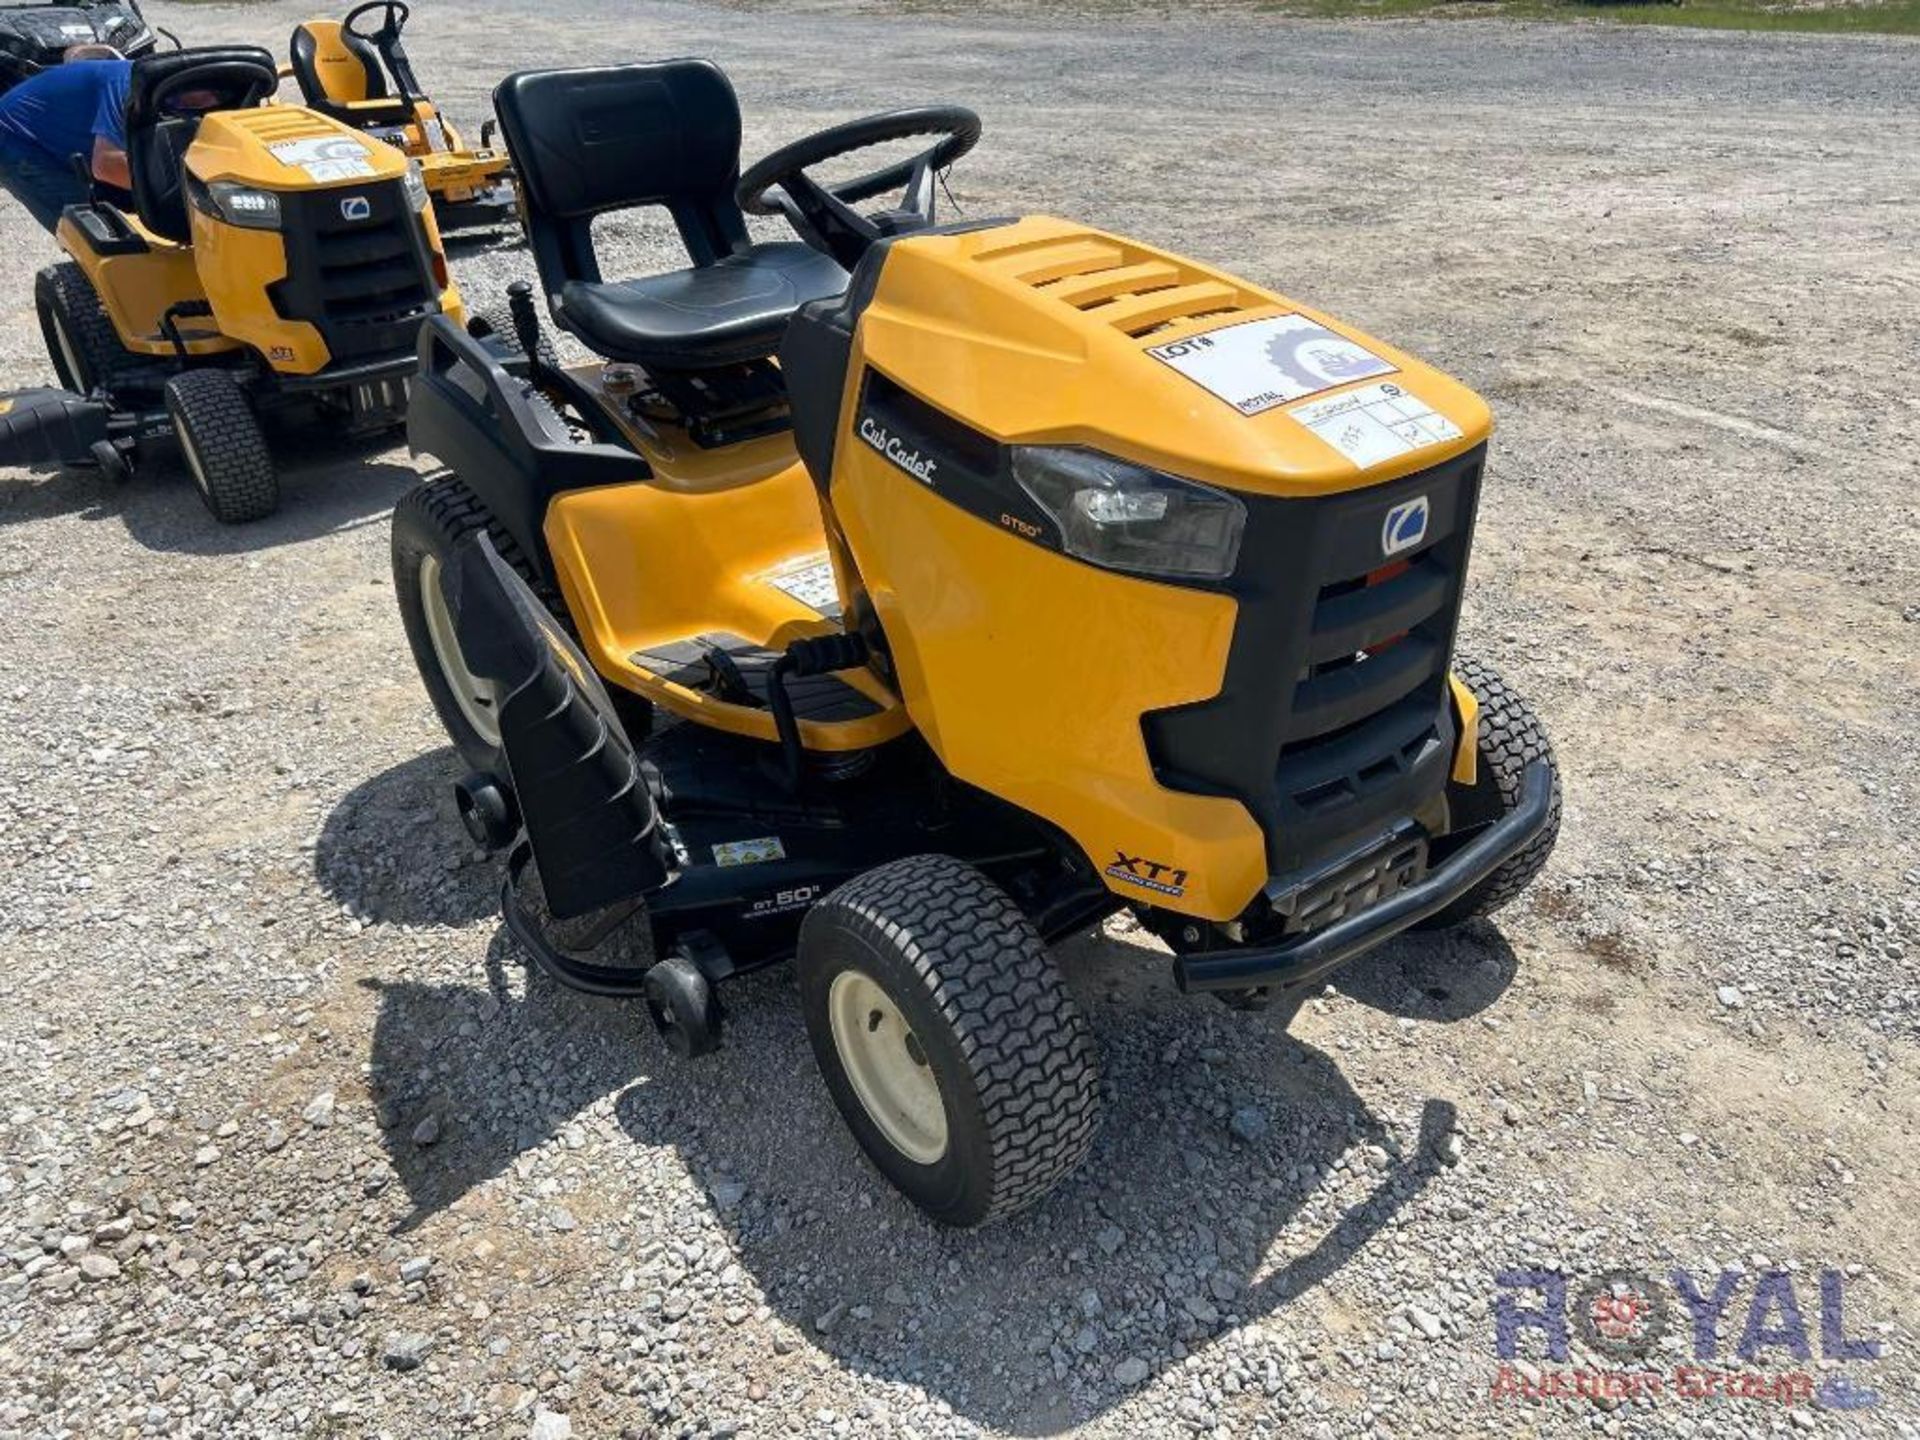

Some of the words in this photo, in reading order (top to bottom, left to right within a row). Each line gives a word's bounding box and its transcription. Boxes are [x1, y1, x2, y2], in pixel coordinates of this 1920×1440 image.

[1152, 336, 1214, 360] LOT#
[861, 418, 887, 451] Cub
[886, 438, 937, 484] Cadet
[1109, 850, 1188, 886] XT1
